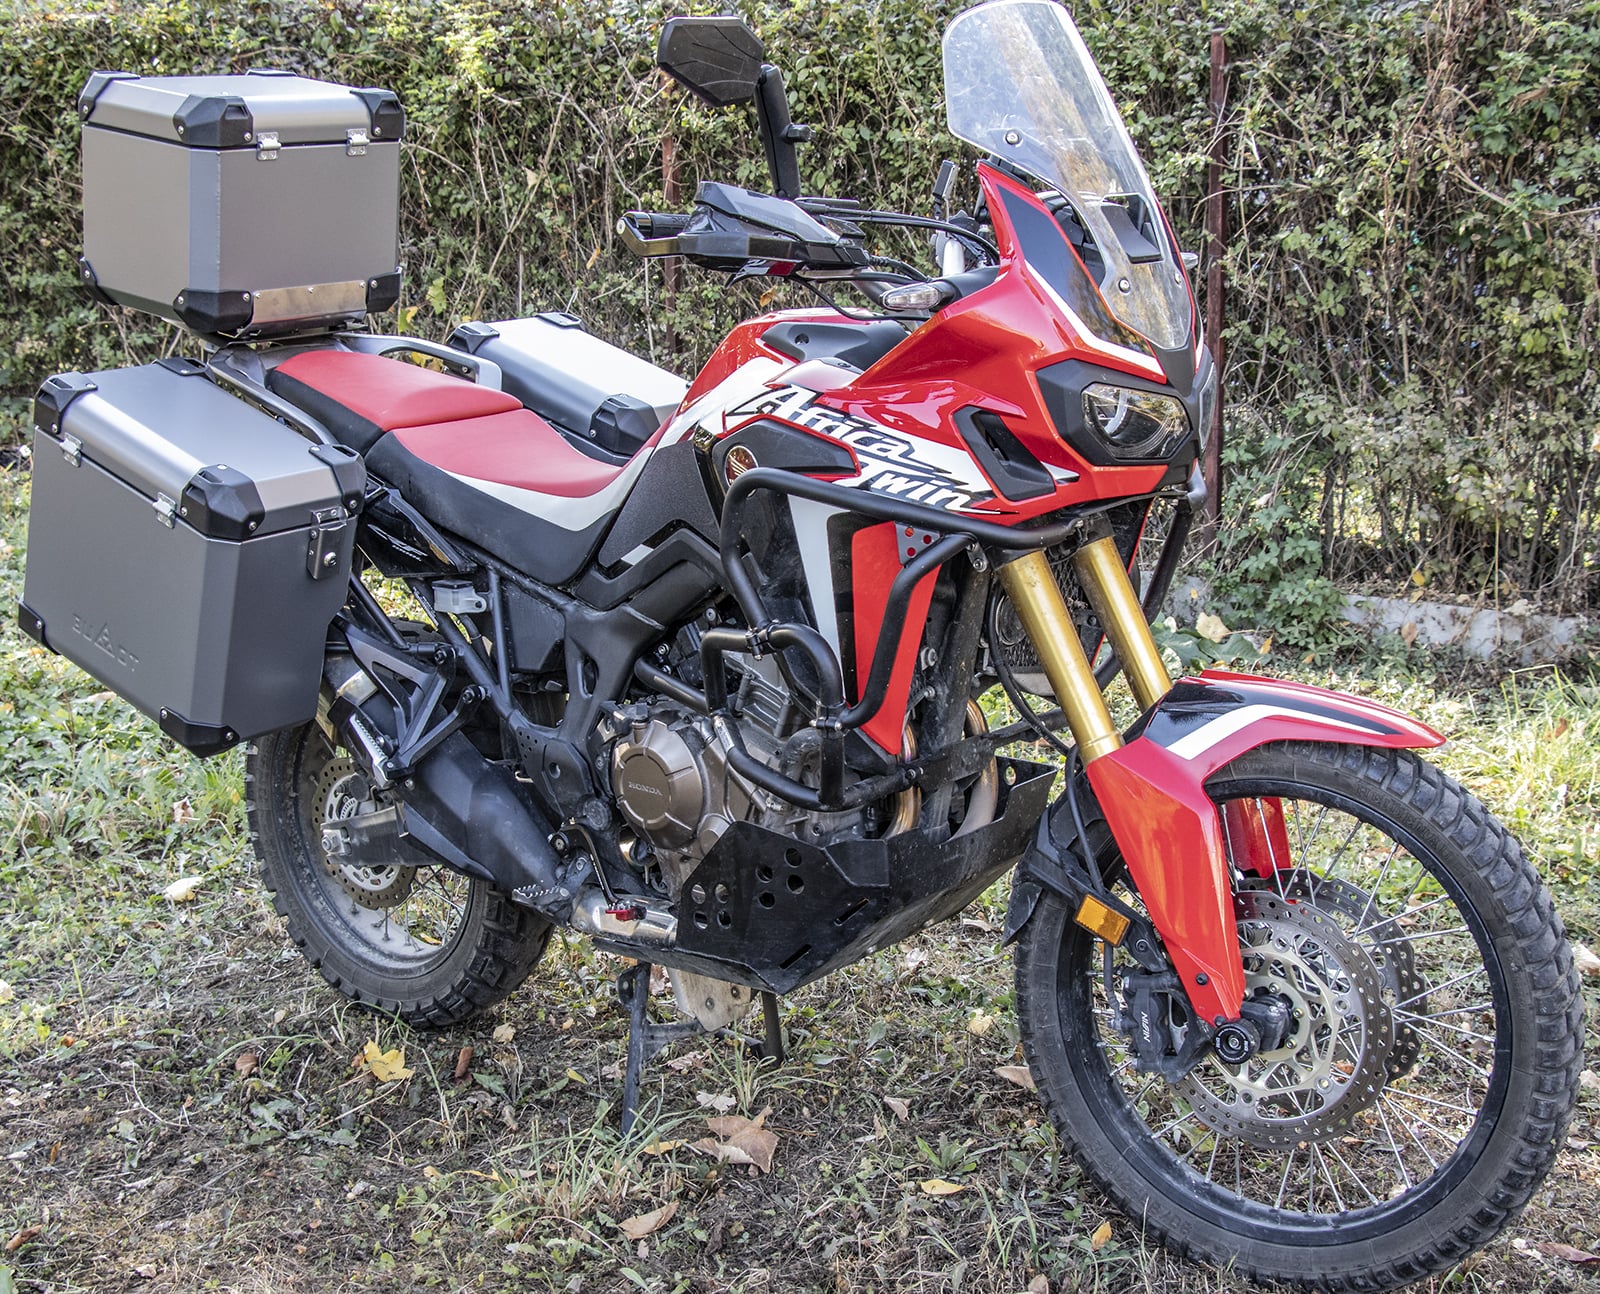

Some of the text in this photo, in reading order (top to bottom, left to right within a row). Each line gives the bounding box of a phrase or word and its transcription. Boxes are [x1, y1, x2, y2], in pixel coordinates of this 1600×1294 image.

[724, 383, 946, 472] Africa
[830, 451, 1012, 515] Twin
[628, 782, 662, 796] HONDA
